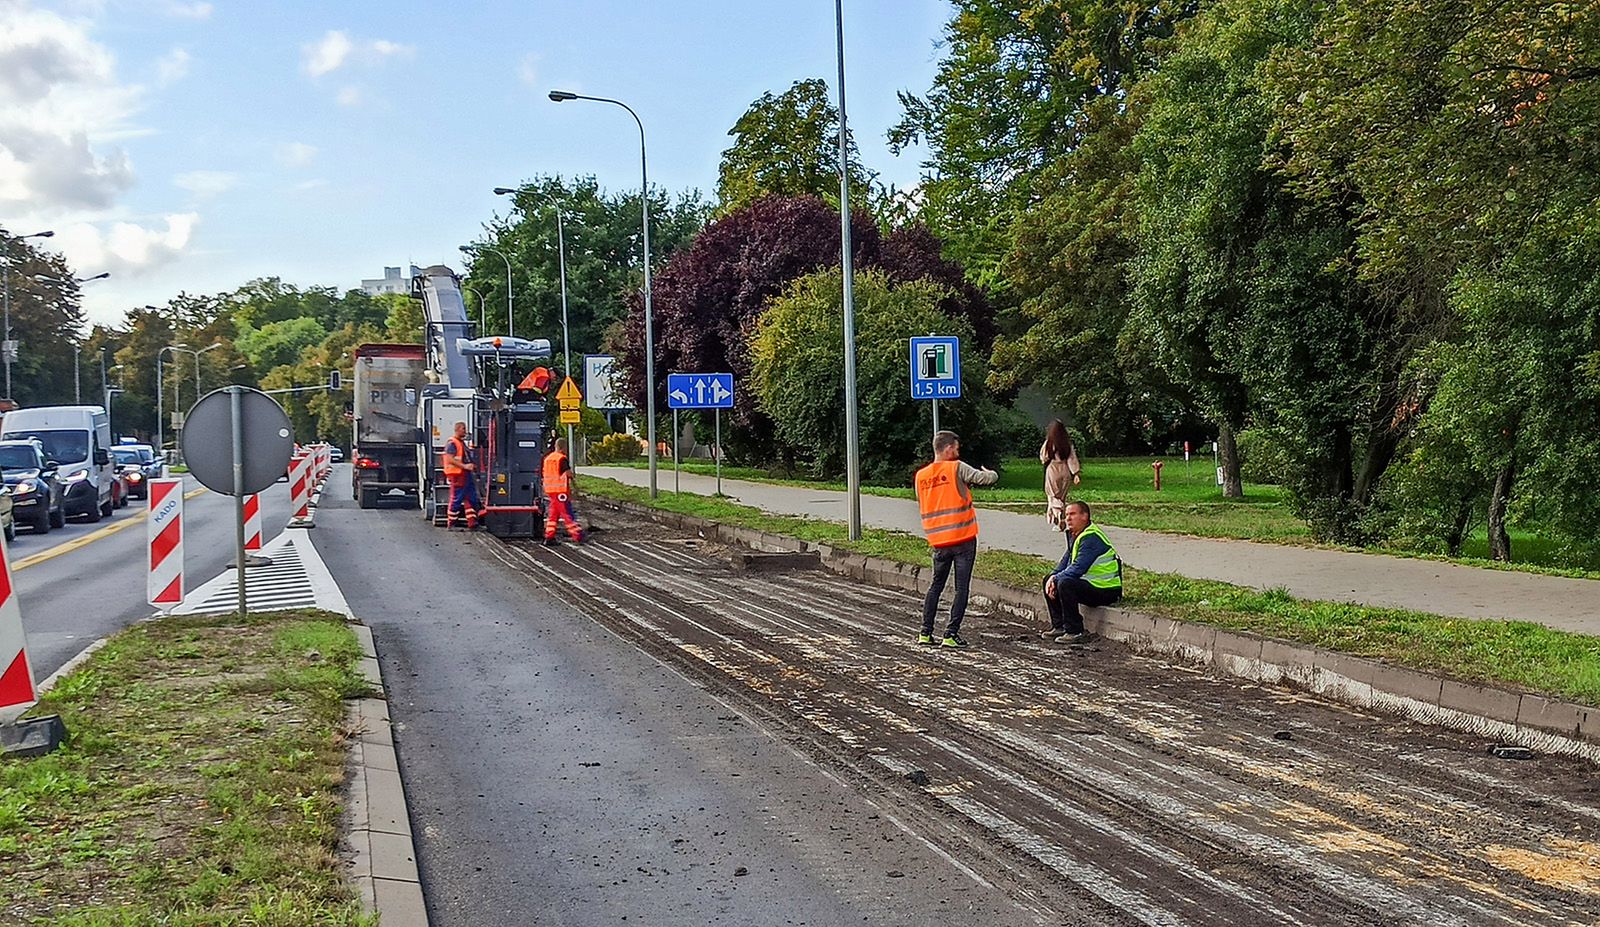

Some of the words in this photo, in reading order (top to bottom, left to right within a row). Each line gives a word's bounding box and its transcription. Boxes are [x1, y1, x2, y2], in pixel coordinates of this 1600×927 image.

[915, 382, 933, 396] 1,5
[937, 382, 957, 395] km
[371, 390, 389, 403] PP
[154, 500, 177, 523] KADO
